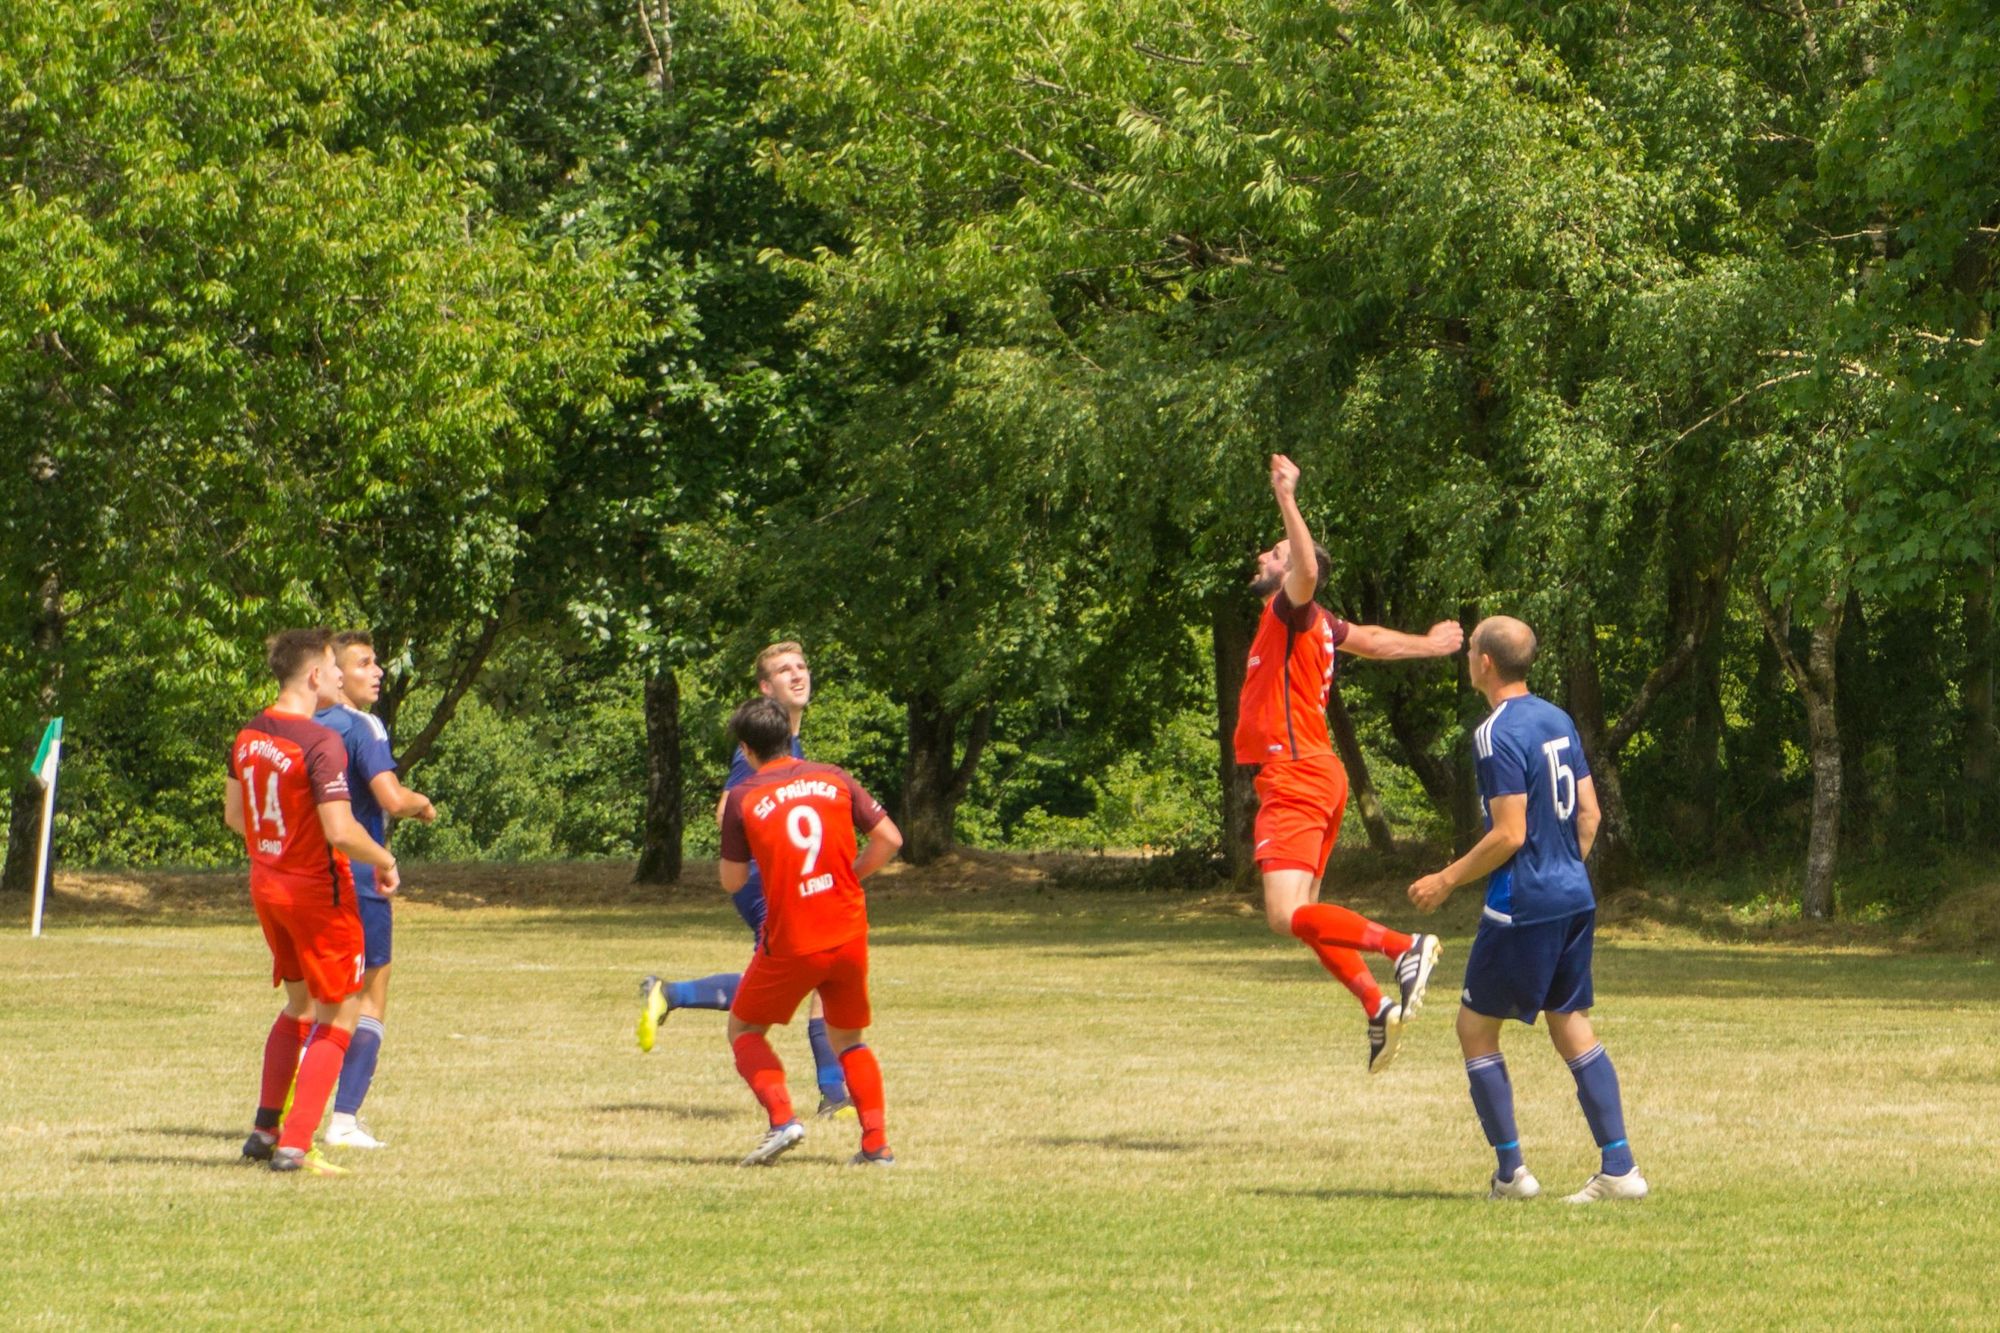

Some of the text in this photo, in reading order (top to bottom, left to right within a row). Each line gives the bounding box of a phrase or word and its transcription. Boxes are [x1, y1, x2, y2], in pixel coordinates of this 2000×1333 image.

[243, 765, 286, 837] 14
[753, 779, 837, 819] SG PRÜMER
[1542, 736, 1575, 820] 15
[258, 839, 283, 856] LAND
[786, 805, 822, 875] 9
[799, 873, 833, 897] LAND
